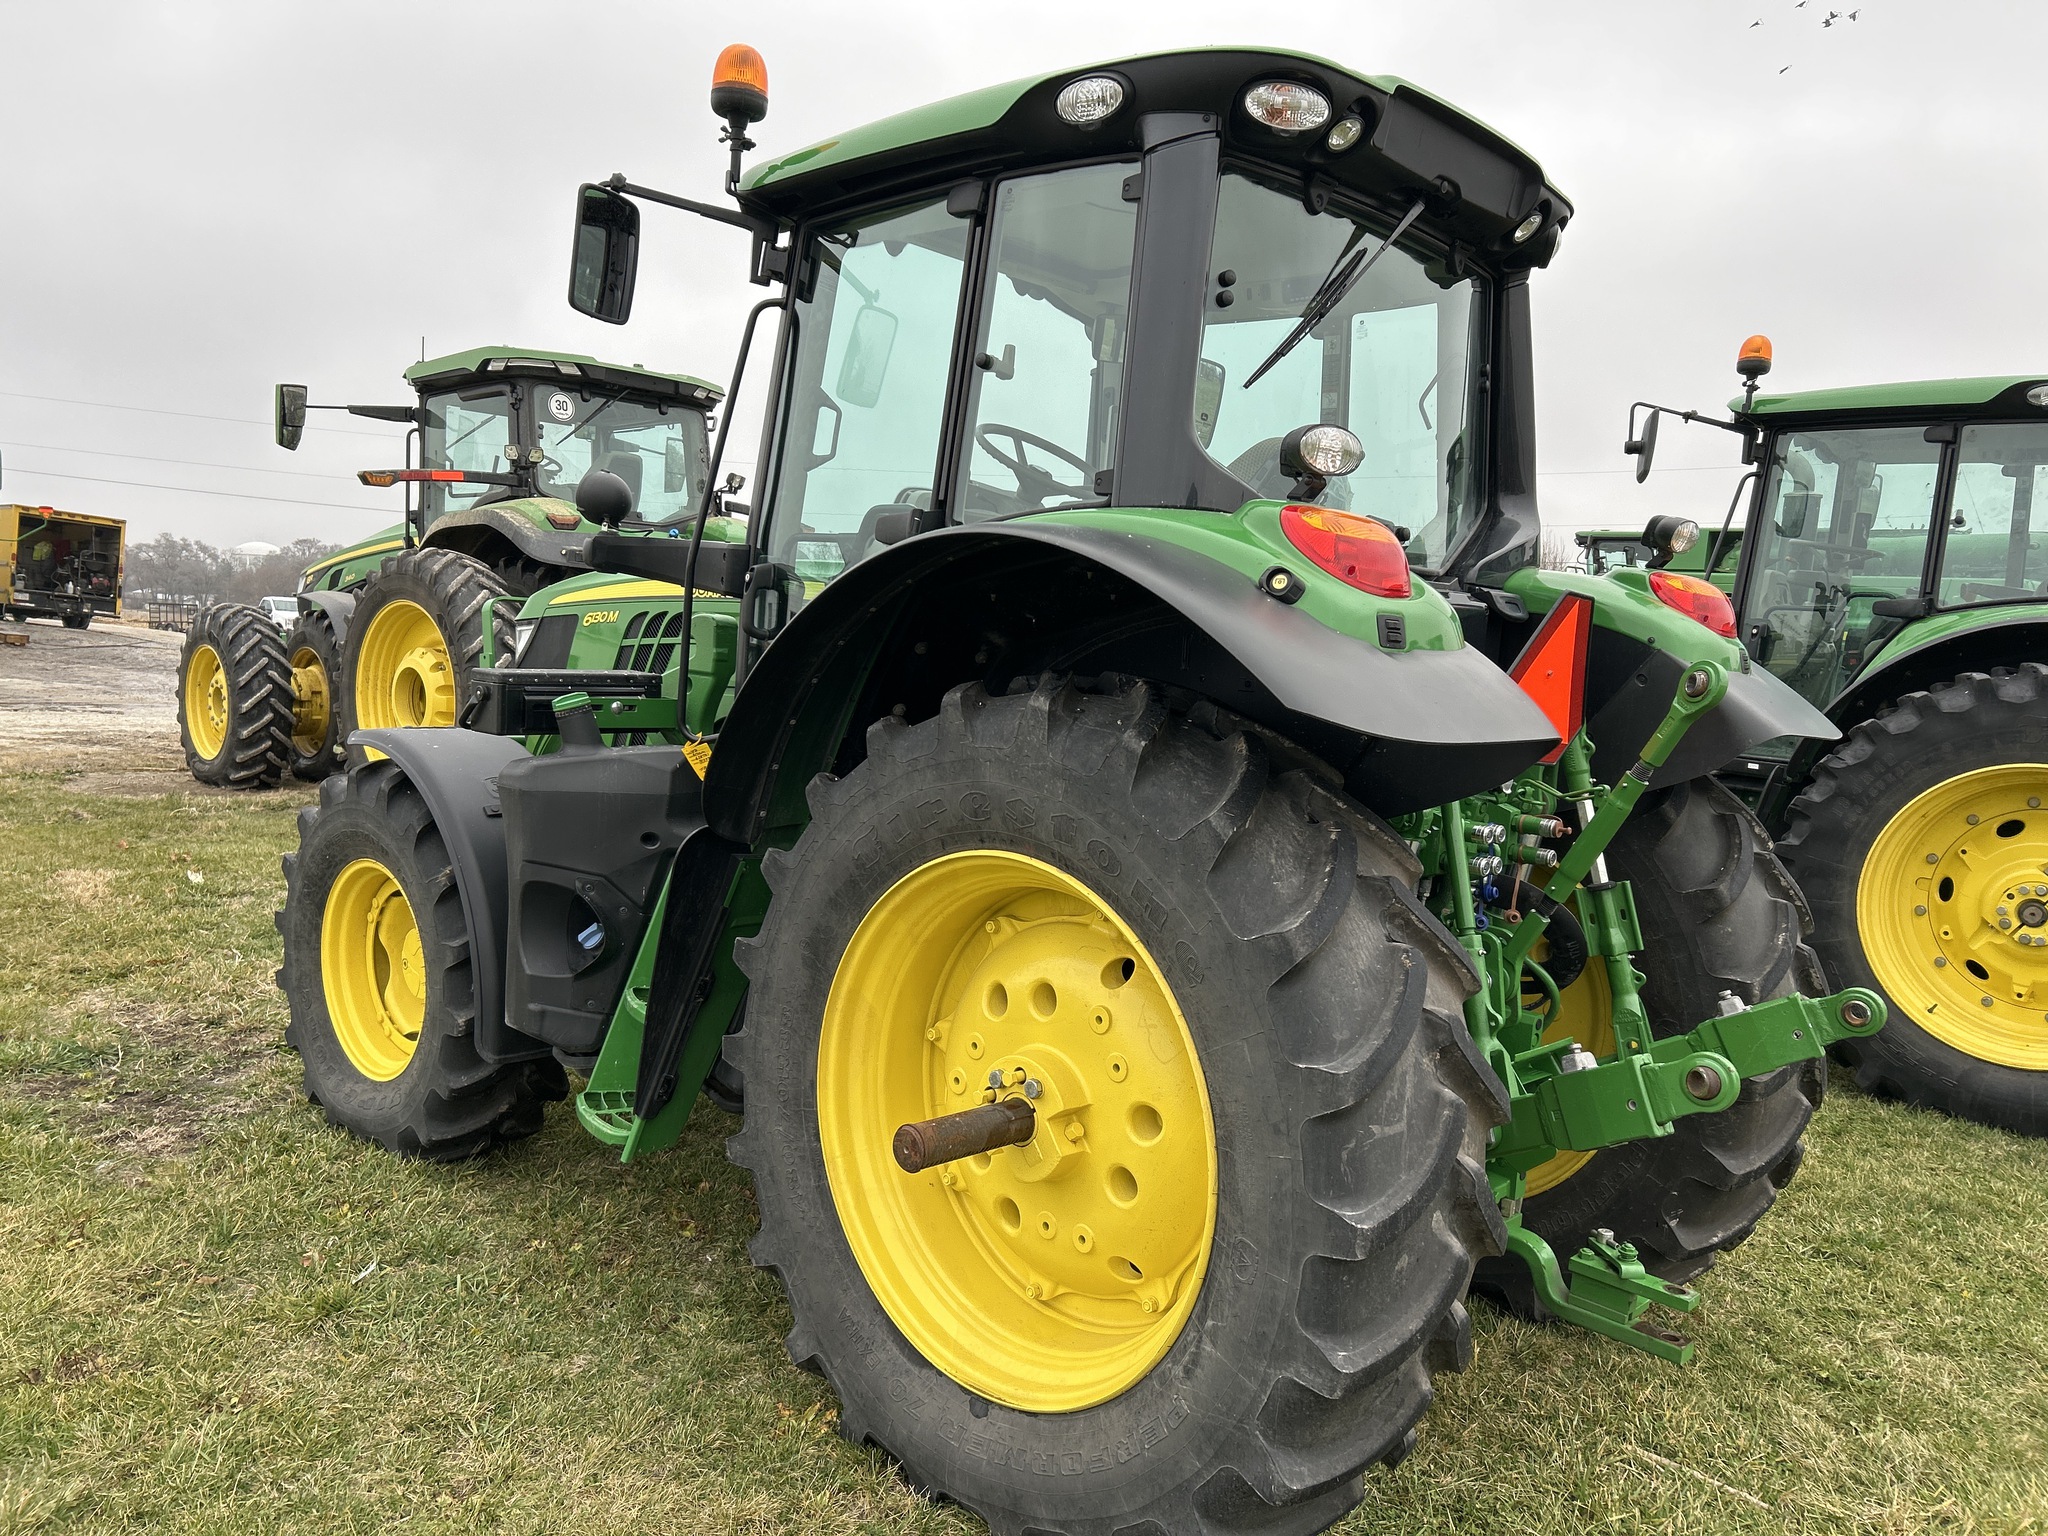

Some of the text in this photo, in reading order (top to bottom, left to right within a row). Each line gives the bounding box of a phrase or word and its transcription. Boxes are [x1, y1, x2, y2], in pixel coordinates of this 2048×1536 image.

[555, 399, 568, 411] 30
[582, 610, 620, 627] 6130M
[837, 1305, 881, 1373] EXTRA
[938, 1396, 1190, 1477] PERFORMER
